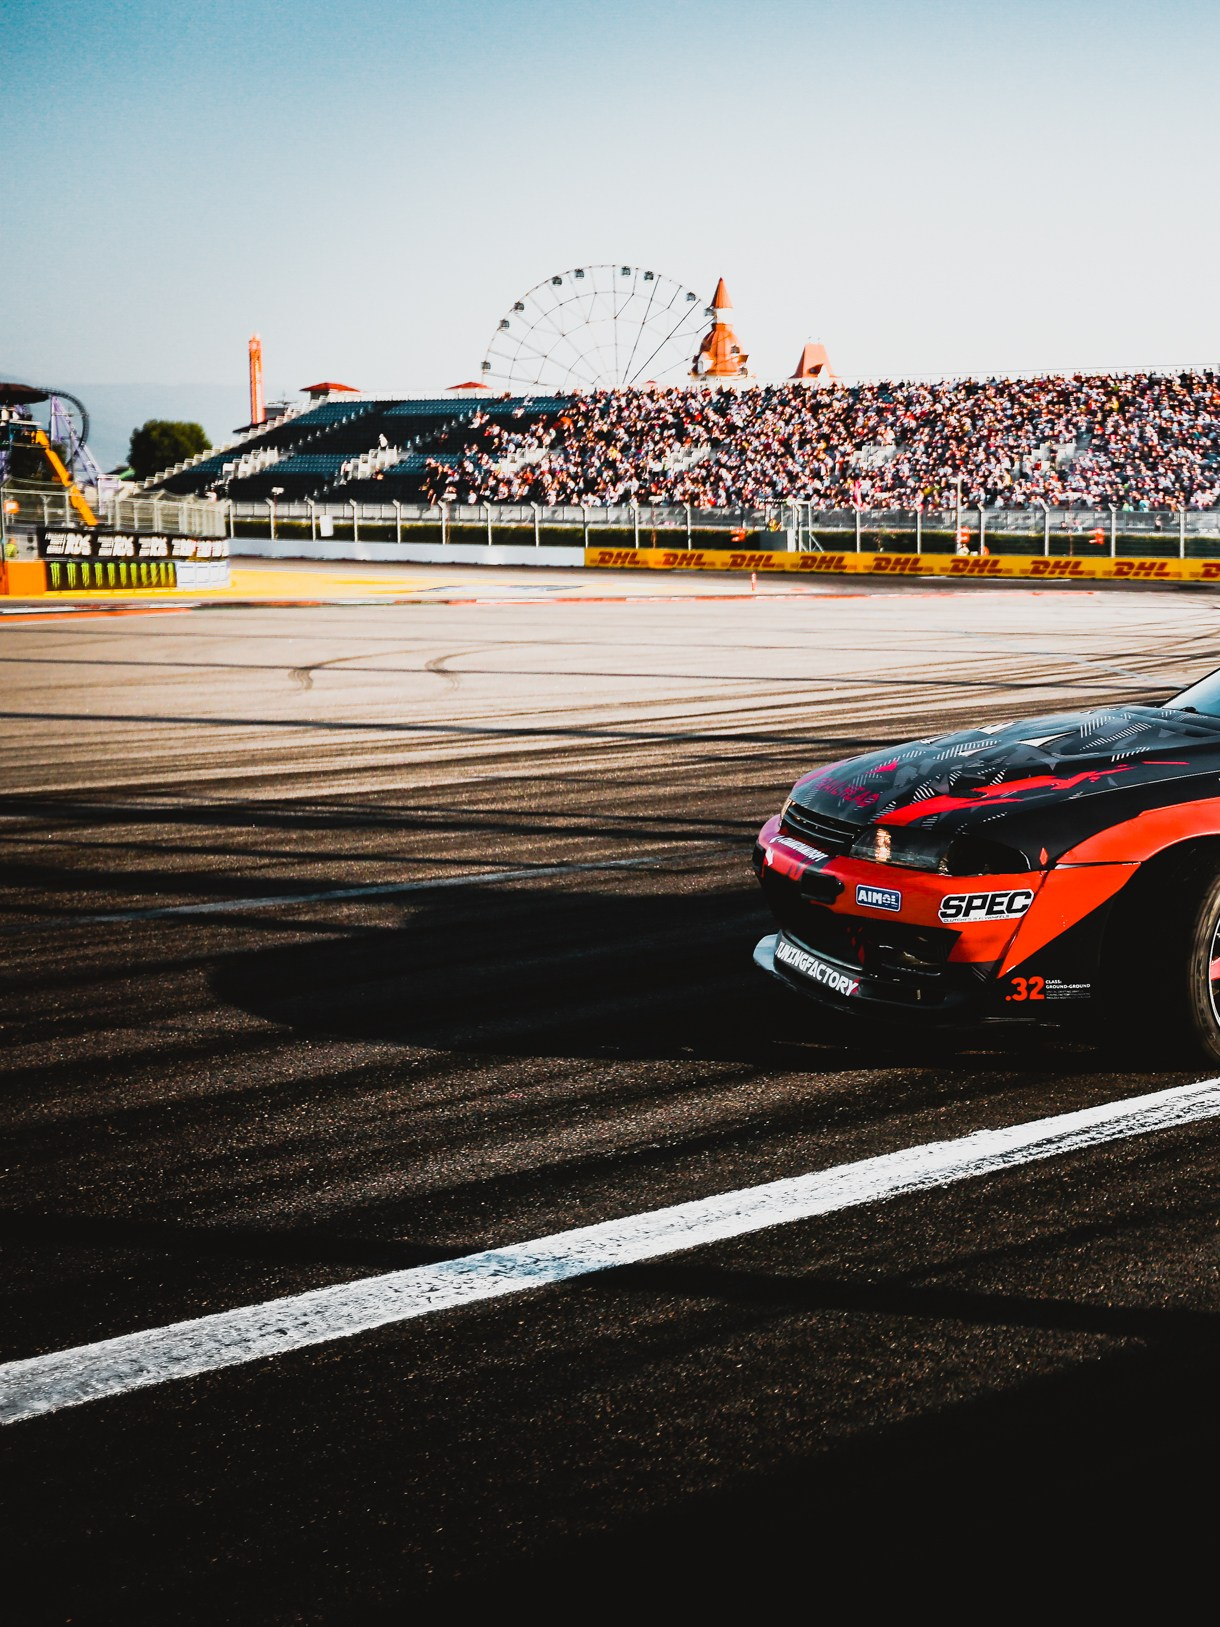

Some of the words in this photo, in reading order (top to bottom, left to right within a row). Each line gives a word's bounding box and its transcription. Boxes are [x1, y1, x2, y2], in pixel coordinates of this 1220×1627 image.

[598, 551, 641, 566] DHL
[663, 552, 708, 567] DHL
[729, 553, 777, 568] DHL
[800, 555, 849, 571] DHL
[872, 556, 924, 572] DHL
[950, 558, 1004, 574] DHL
[1029, 560, 1086, 576] DHL
[1113, 561, 1172, 577] DHL
[858, 889, 899, 907] AIMOL
[939, 891, 1032, 919] SPEC
[775, 941, 859, 996] TUNINGFACTORY
